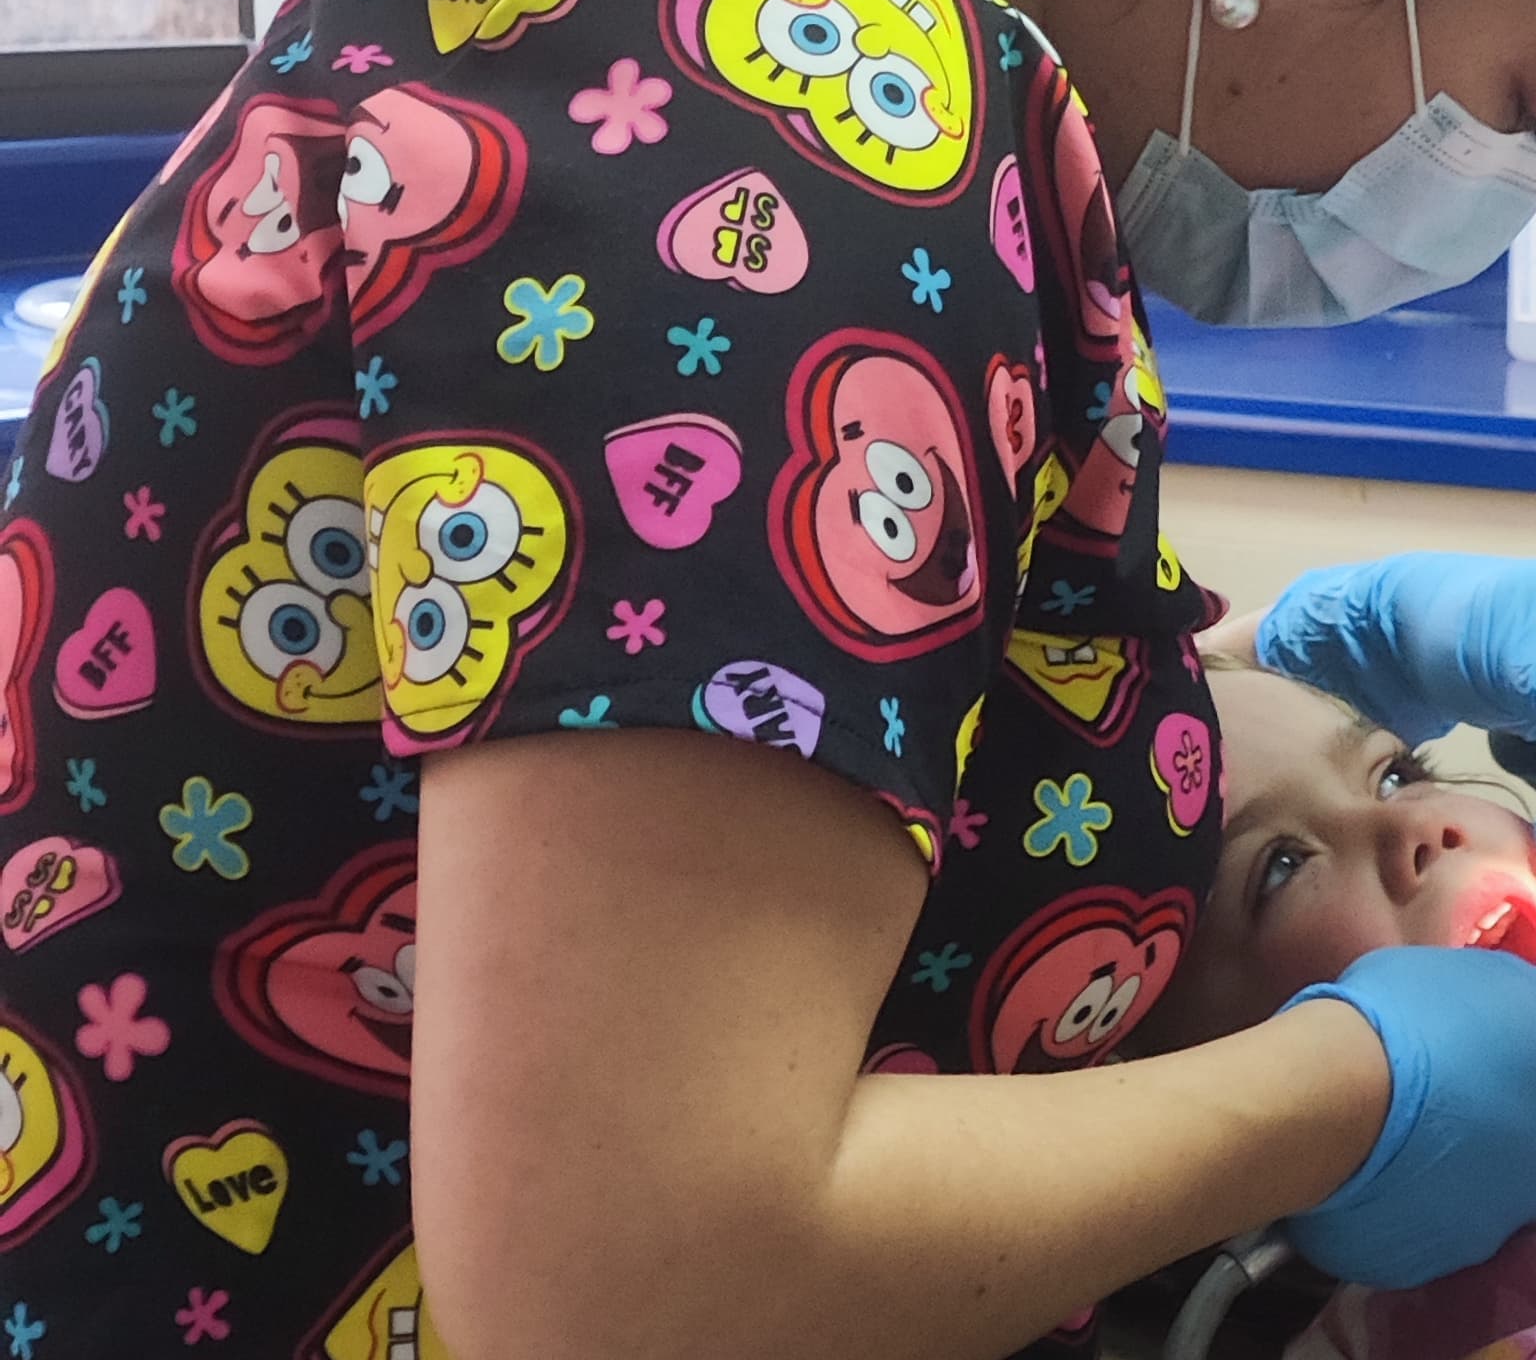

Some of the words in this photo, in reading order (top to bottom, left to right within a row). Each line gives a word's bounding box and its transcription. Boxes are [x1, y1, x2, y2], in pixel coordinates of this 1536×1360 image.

[643, 442, 706, 517] BFF
[78, 621, 132, 691] BFF
[725, 667, 800, 752] ARY
[184, 1165, 277, 1214] Love
